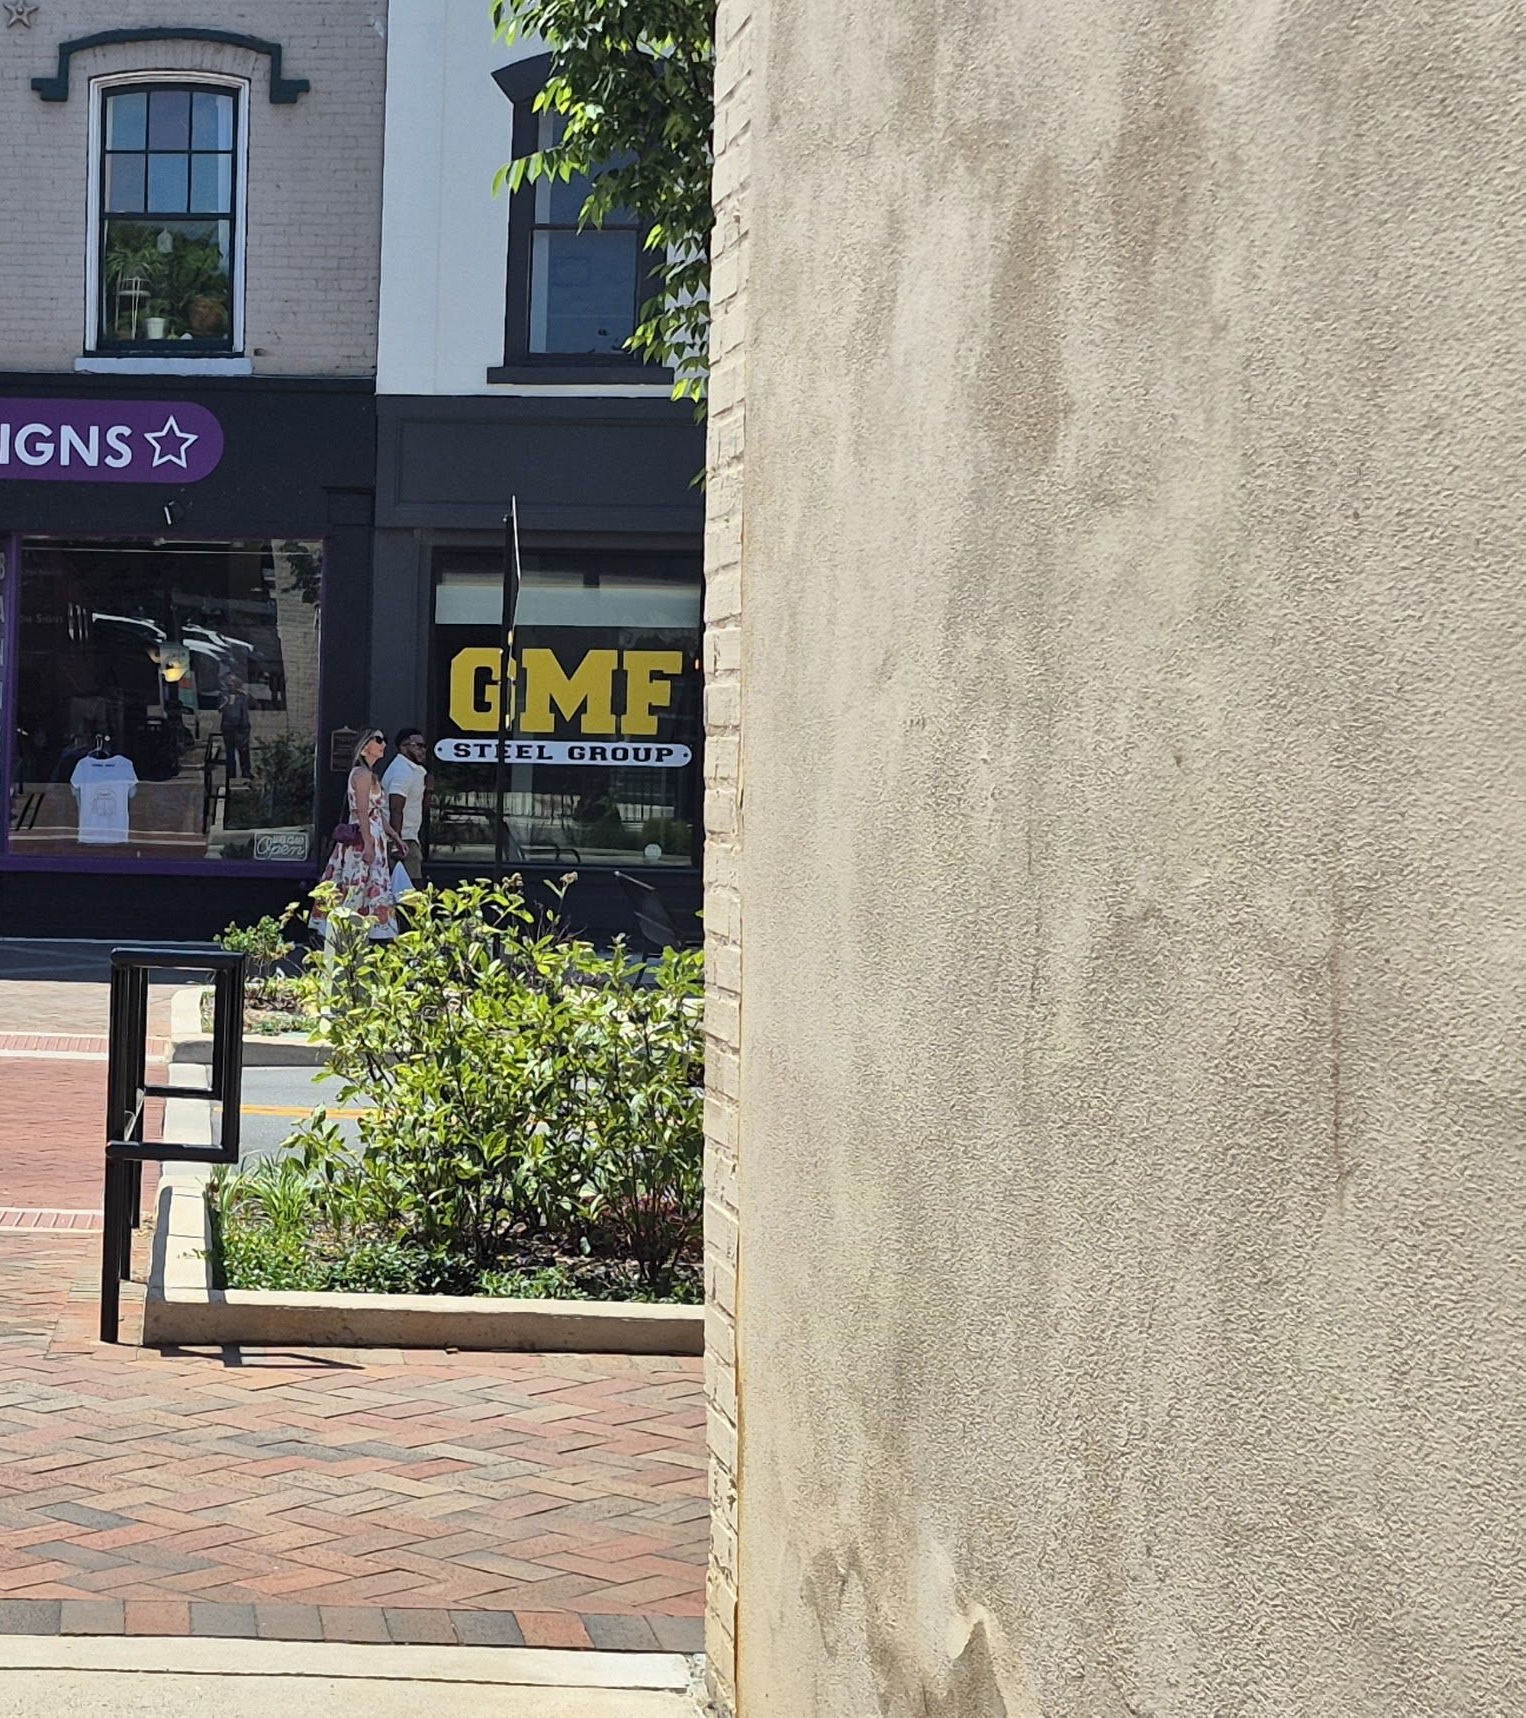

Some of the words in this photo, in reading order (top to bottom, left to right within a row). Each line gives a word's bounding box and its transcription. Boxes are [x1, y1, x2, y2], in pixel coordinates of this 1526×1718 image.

[449, 647, 684, 736] GMF
[454, 743, 553, 760] STEEL
[568, 746, 674, 763] GROUP
